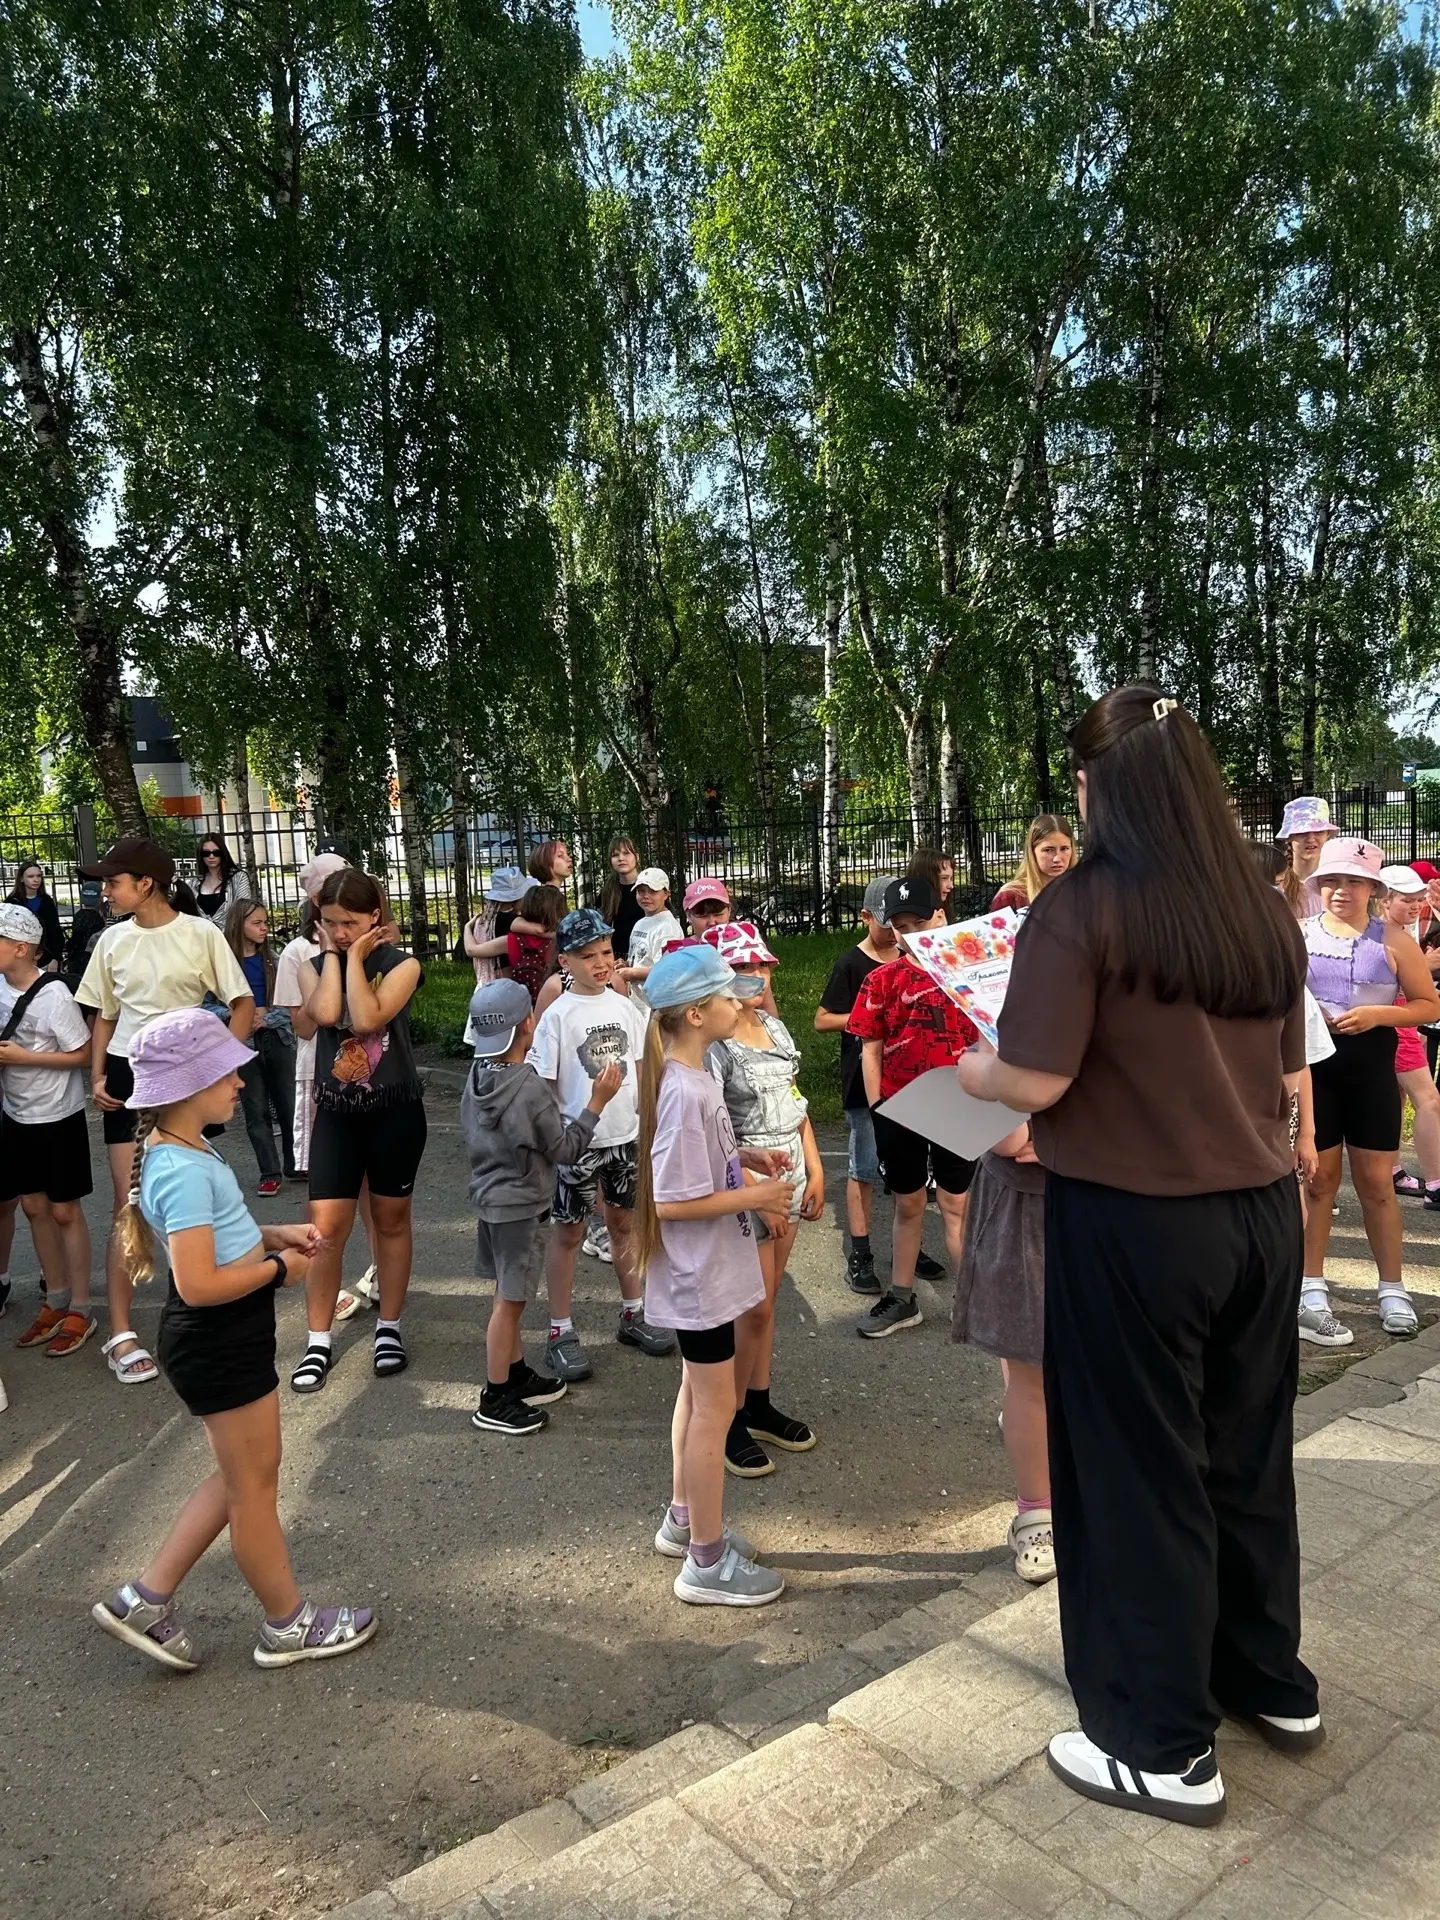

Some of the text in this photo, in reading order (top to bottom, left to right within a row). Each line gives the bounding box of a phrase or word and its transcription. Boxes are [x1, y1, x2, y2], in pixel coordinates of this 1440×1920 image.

[968, 969, 1008, 982] Грамота
[585, 1022, 622, 1036] CREATED
[601, 1035, 612, 1044] BY
[591, 1043, 623, 1057] NATURE
